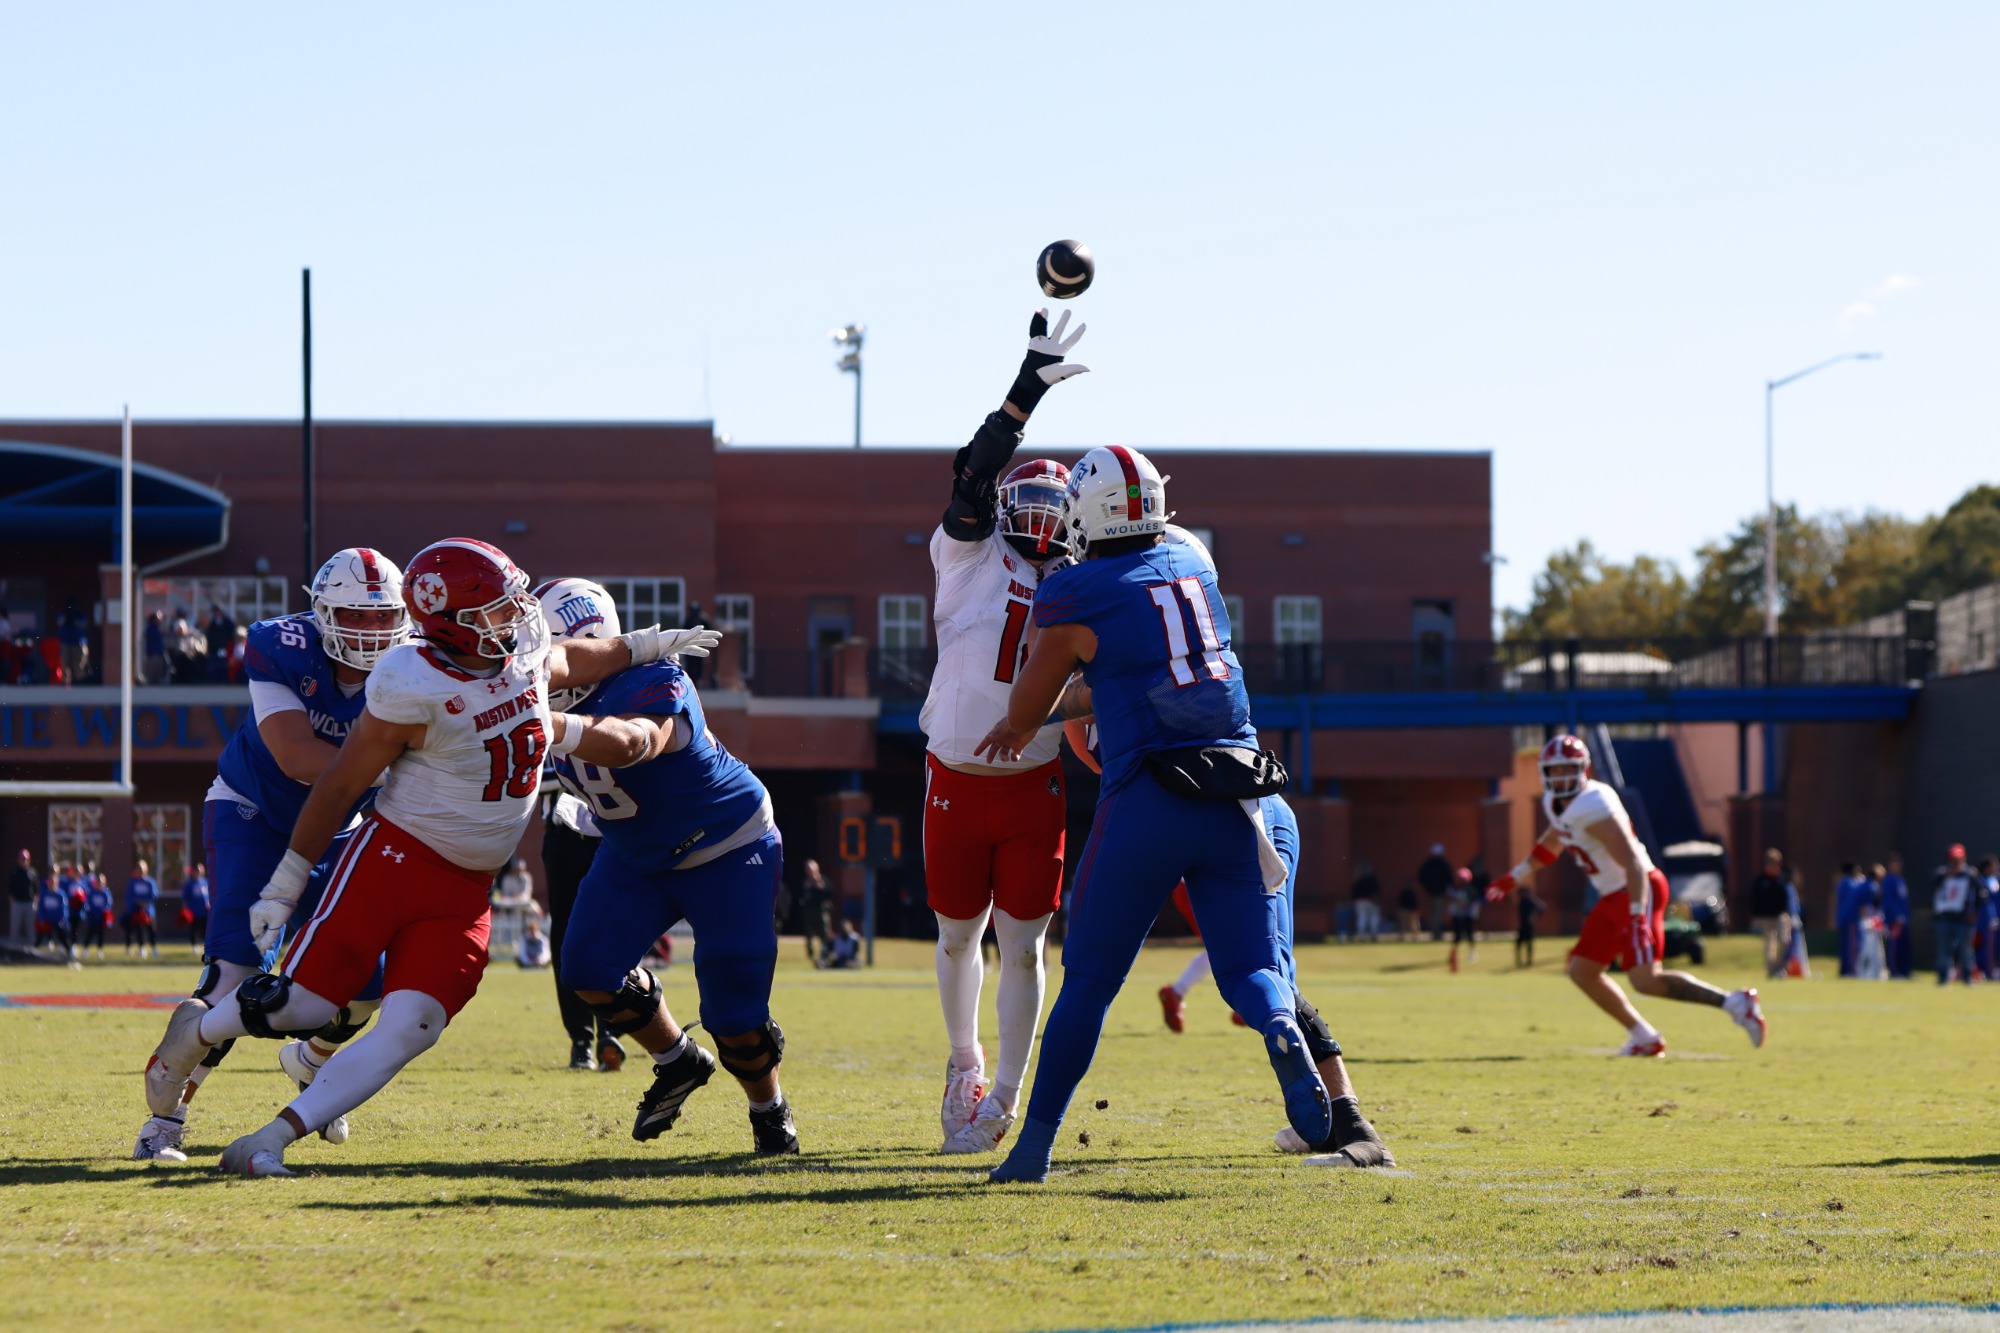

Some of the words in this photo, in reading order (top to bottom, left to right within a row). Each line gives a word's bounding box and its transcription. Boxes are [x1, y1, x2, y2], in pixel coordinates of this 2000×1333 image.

[1105, 522, 1159, 536] WOLVES
[557, 597, 601, 628] UWG
[1147, 576, 1231, 688] 11
[279, 619, 307, 650] 56
[994, 599, 1029, 684] 1
[473, 699, 517, 733] AUSTIN
[482, 718, 546, 801] 18
[840, 816, 901, 861] 07
